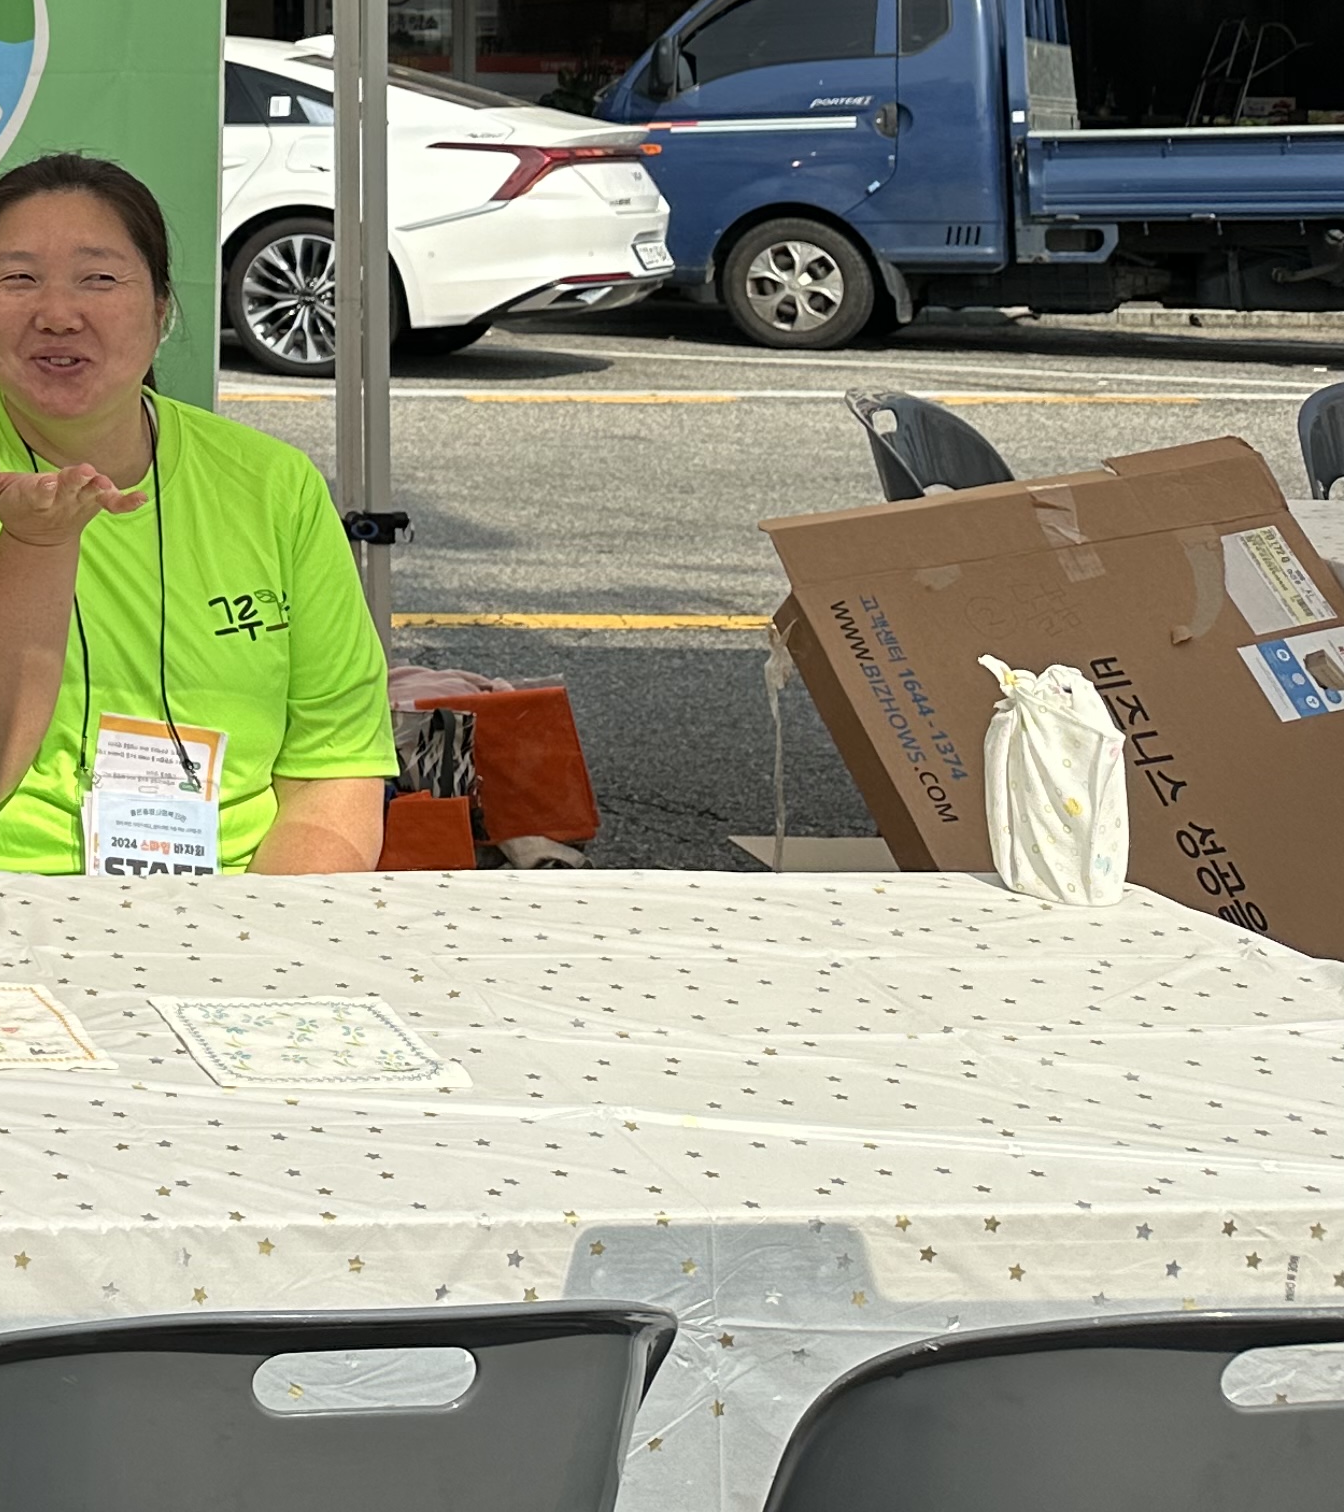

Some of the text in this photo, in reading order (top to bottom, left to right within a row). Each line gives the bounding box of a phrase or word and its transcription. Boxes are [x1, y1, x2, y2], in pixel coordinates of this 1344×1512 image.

[859, 593, 908, 663] 고객센터
[829, 599, 960, 824] WWW.BIZHOWS.COM
[111, 836, 205, 857] 2024 스마일 바자회
[1089, 655, 1269, 934] 비즈니스 성공을
